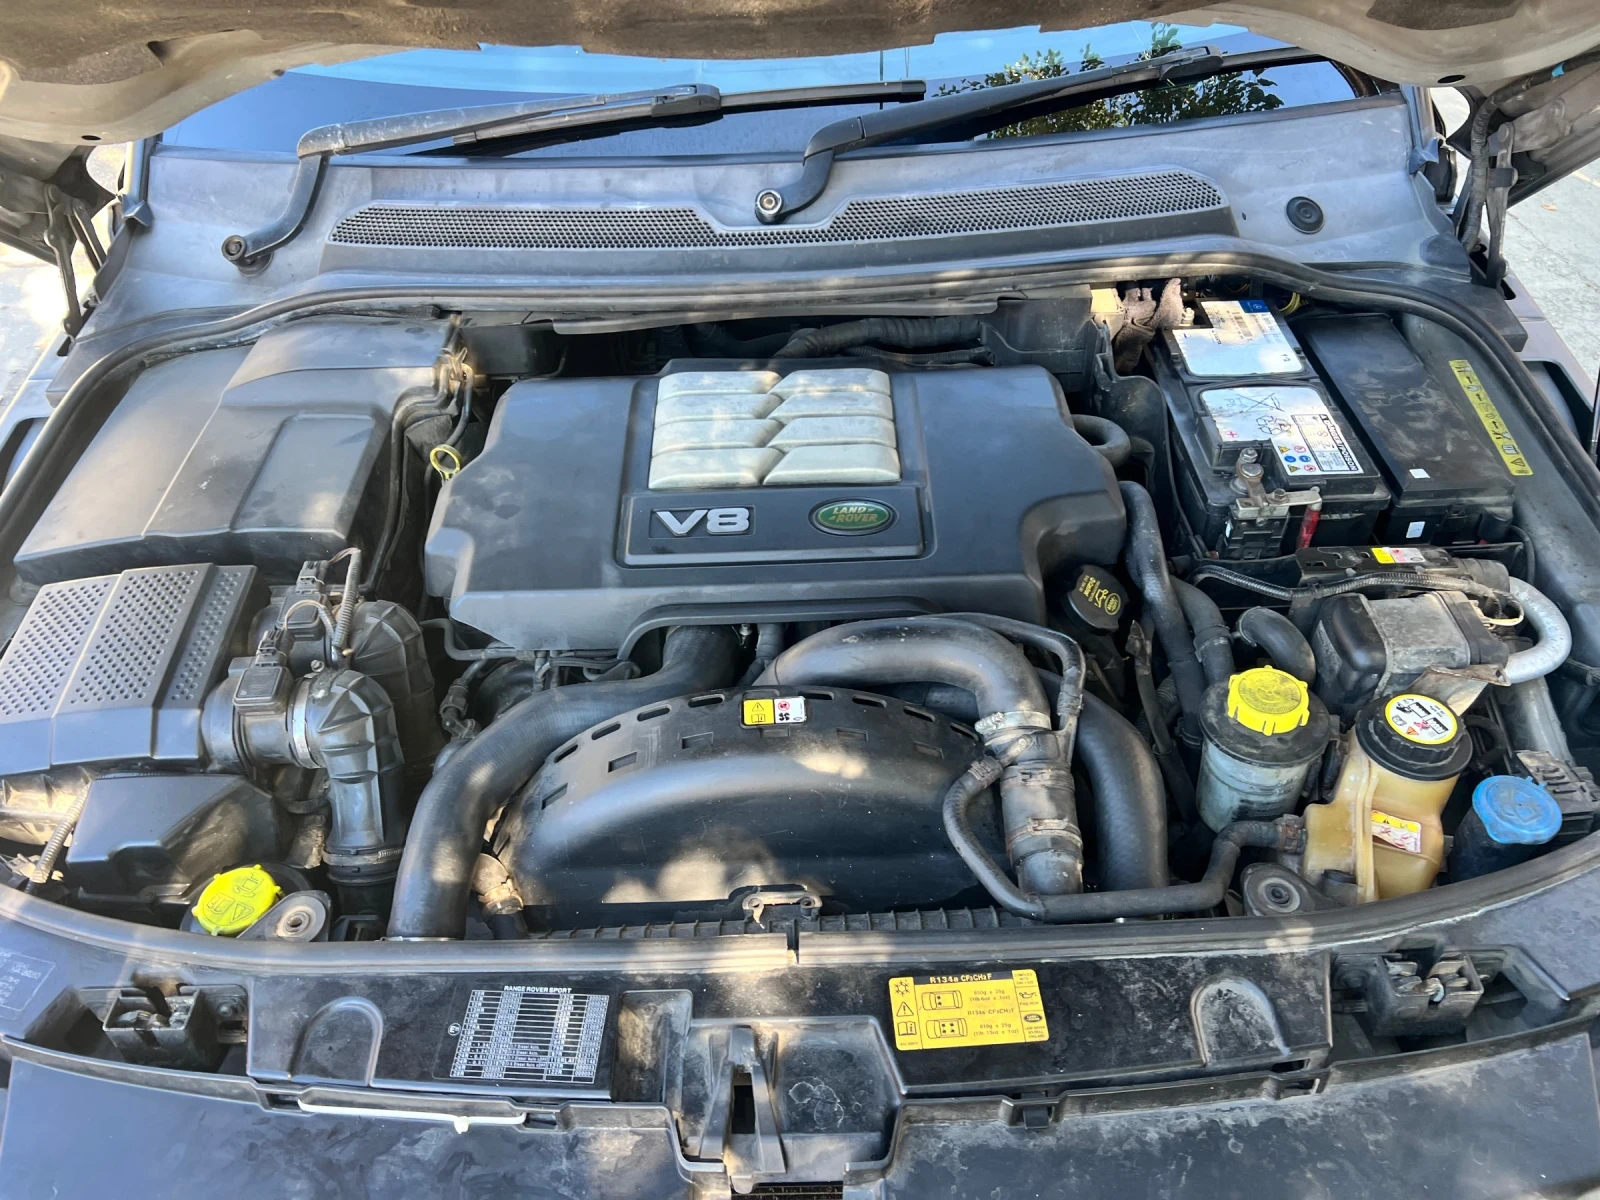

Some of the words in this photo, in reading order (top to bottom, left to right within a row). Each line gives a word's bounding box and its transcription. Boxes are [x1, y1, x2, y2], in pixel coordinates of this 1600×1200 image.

[832, 505, 866, 515] LAND
[656, 507, 750, 536] V8
[835, 513, 878, 523] ROVER
[930, 975, 958, 984] R134a
